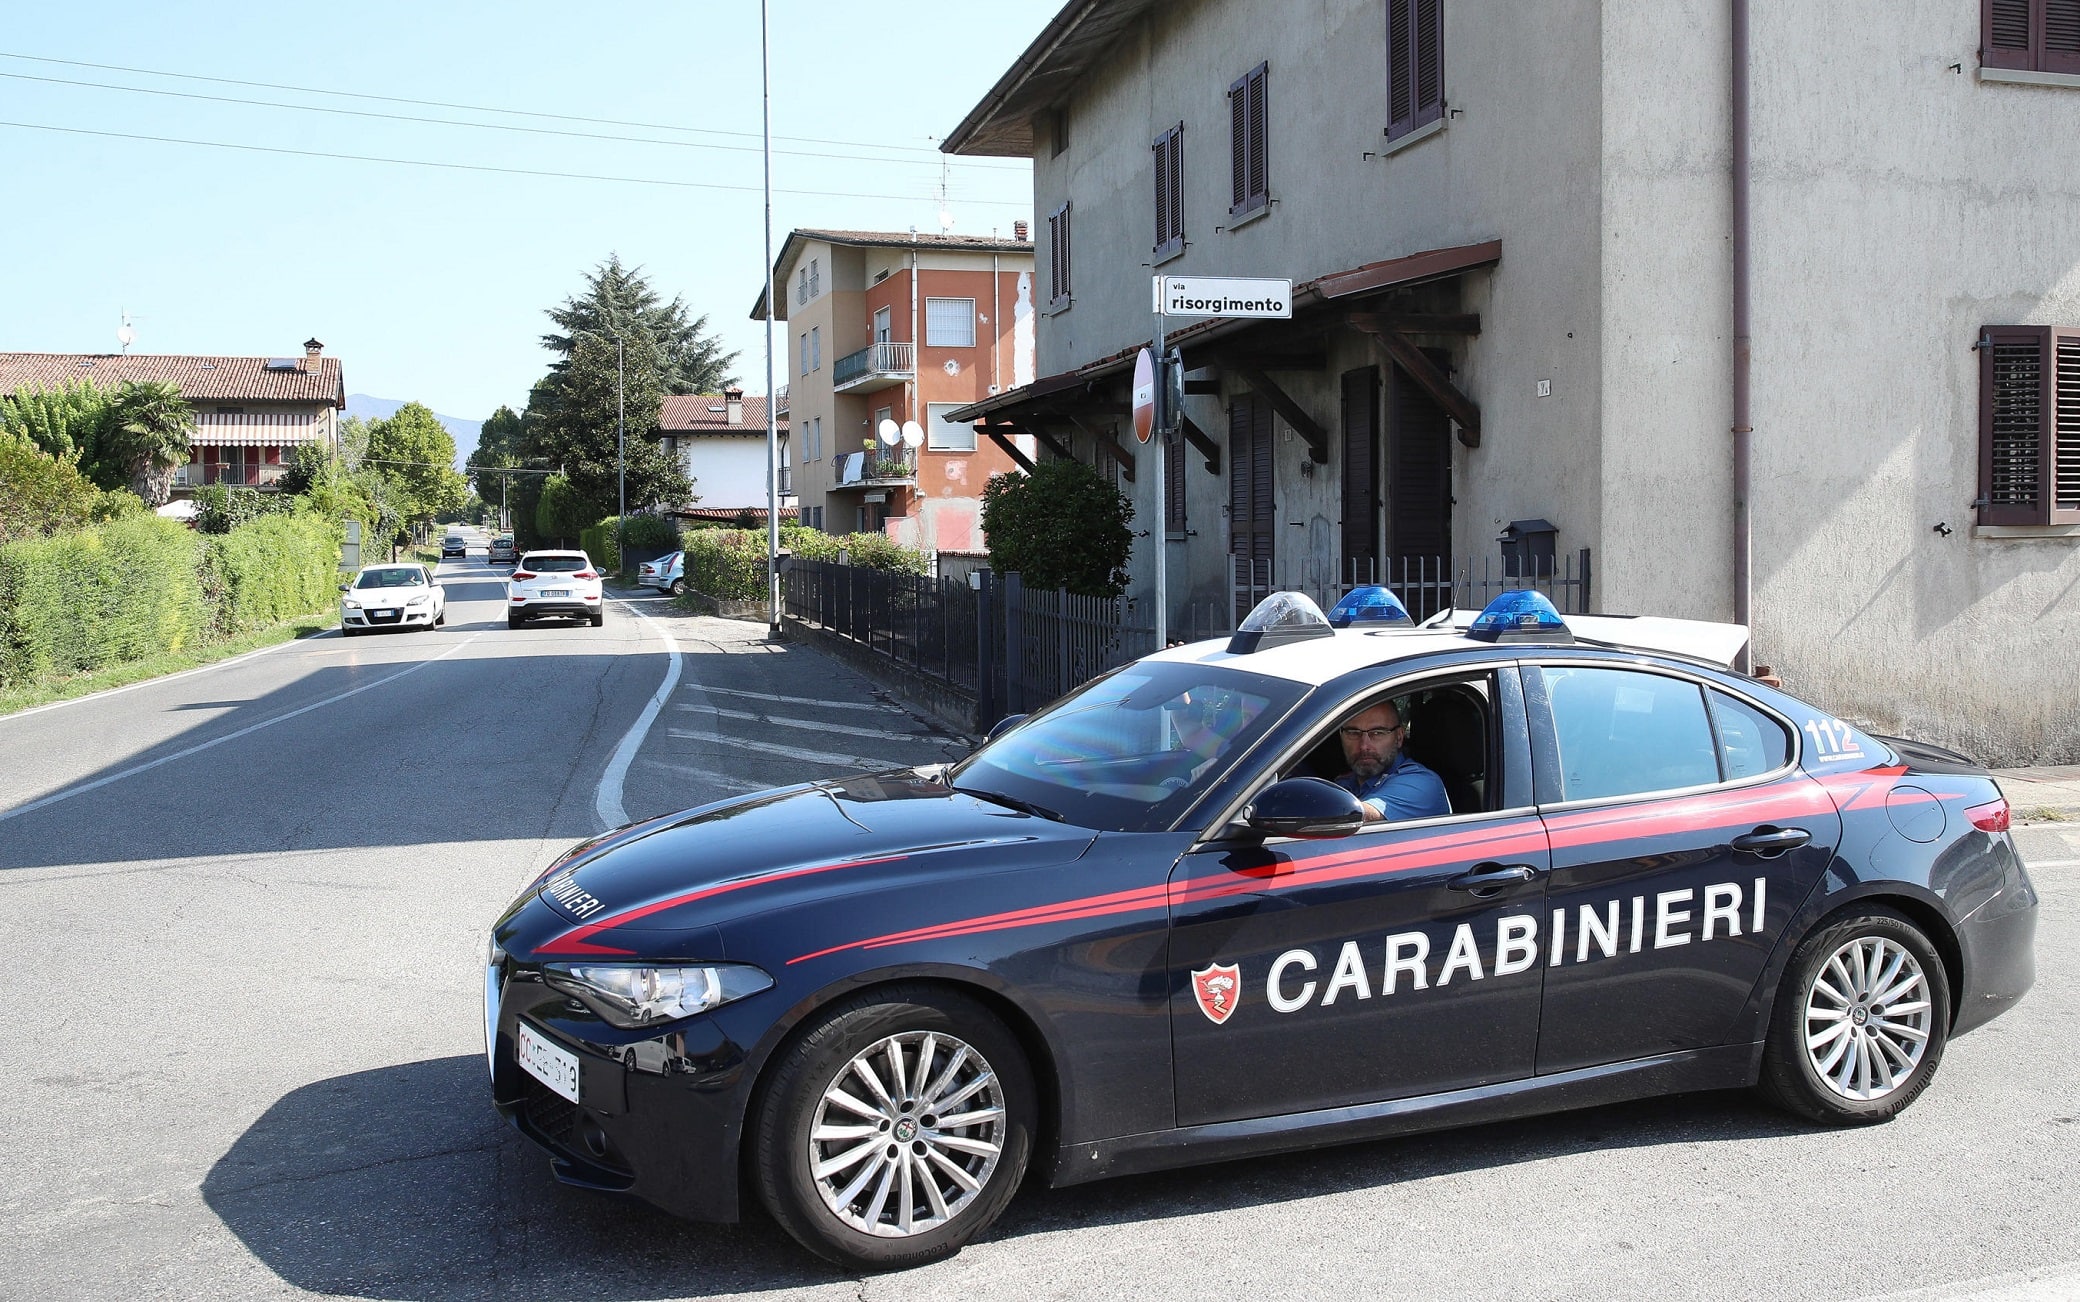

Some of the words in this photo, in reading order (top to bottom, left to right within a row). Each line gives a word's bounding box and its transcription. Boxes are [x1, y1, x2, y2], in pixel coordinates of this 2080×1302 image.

[1173, 282, 1185, 290] via
[1172, 296, 1283, 313] risorgimento
[1804, 718, 1860, 754] 112
[1265, 876, 1768, 1014] CARABINIERI
[1890, 1059, 1938, 1115] Continental
